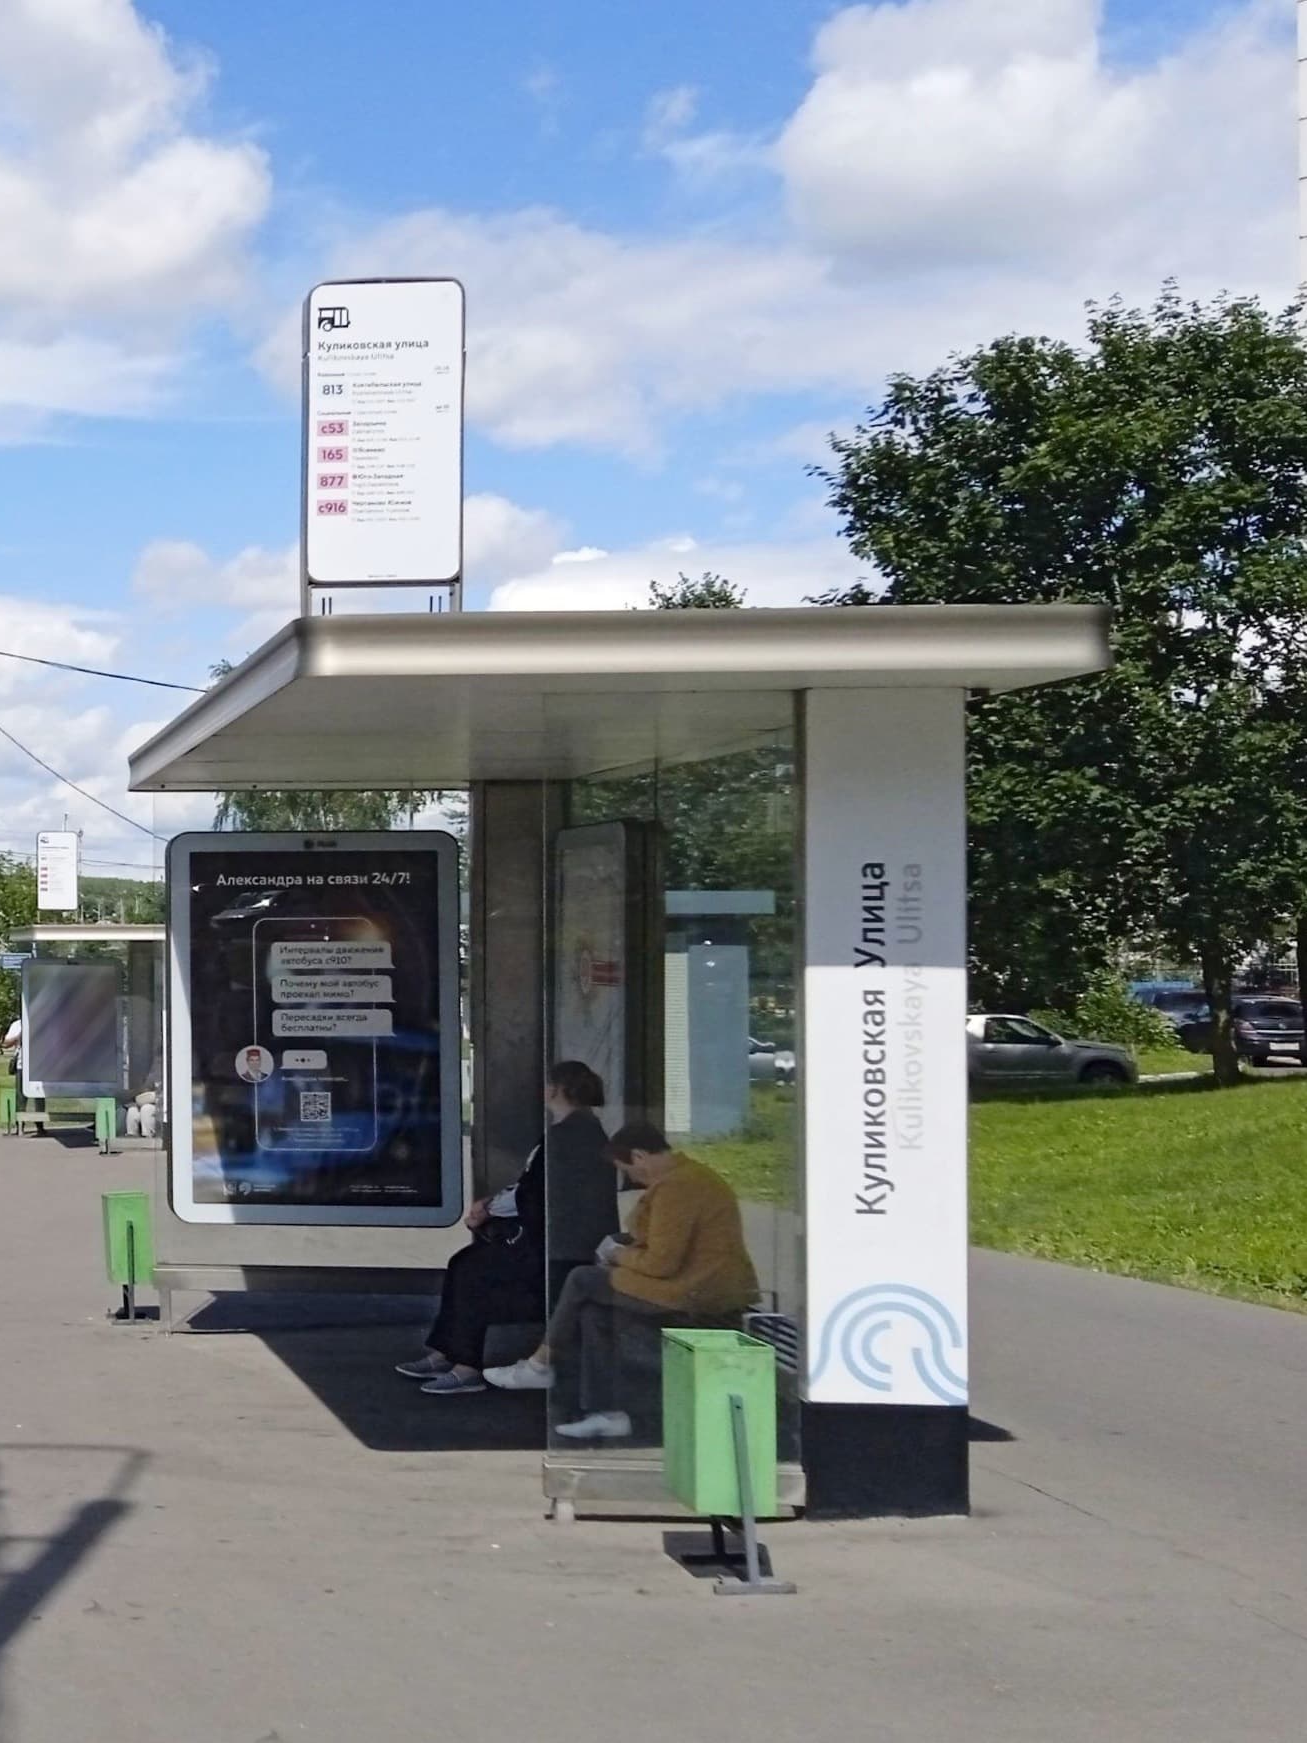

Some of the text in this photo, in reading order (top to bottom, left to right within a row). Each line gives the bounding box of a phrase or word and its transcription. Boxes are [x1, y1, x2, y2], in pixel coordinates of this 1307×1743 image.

[318, 340, 429, 353] Куликовская улица
[322, 384, 343, 395] 813
[322, 449, 343, 460] 165
[320, 476, 344, 487] 877
[216, 872, 410, 888] Александра на связи 24/7!
[280, 979, 318, 989] Почему
[896, 863, 930, 1150] Kulikovskaya Ulitsa
[280, 1013, 334, 1023] Пересадки
[853, 861, 895, 1215] Куликовская Улица
